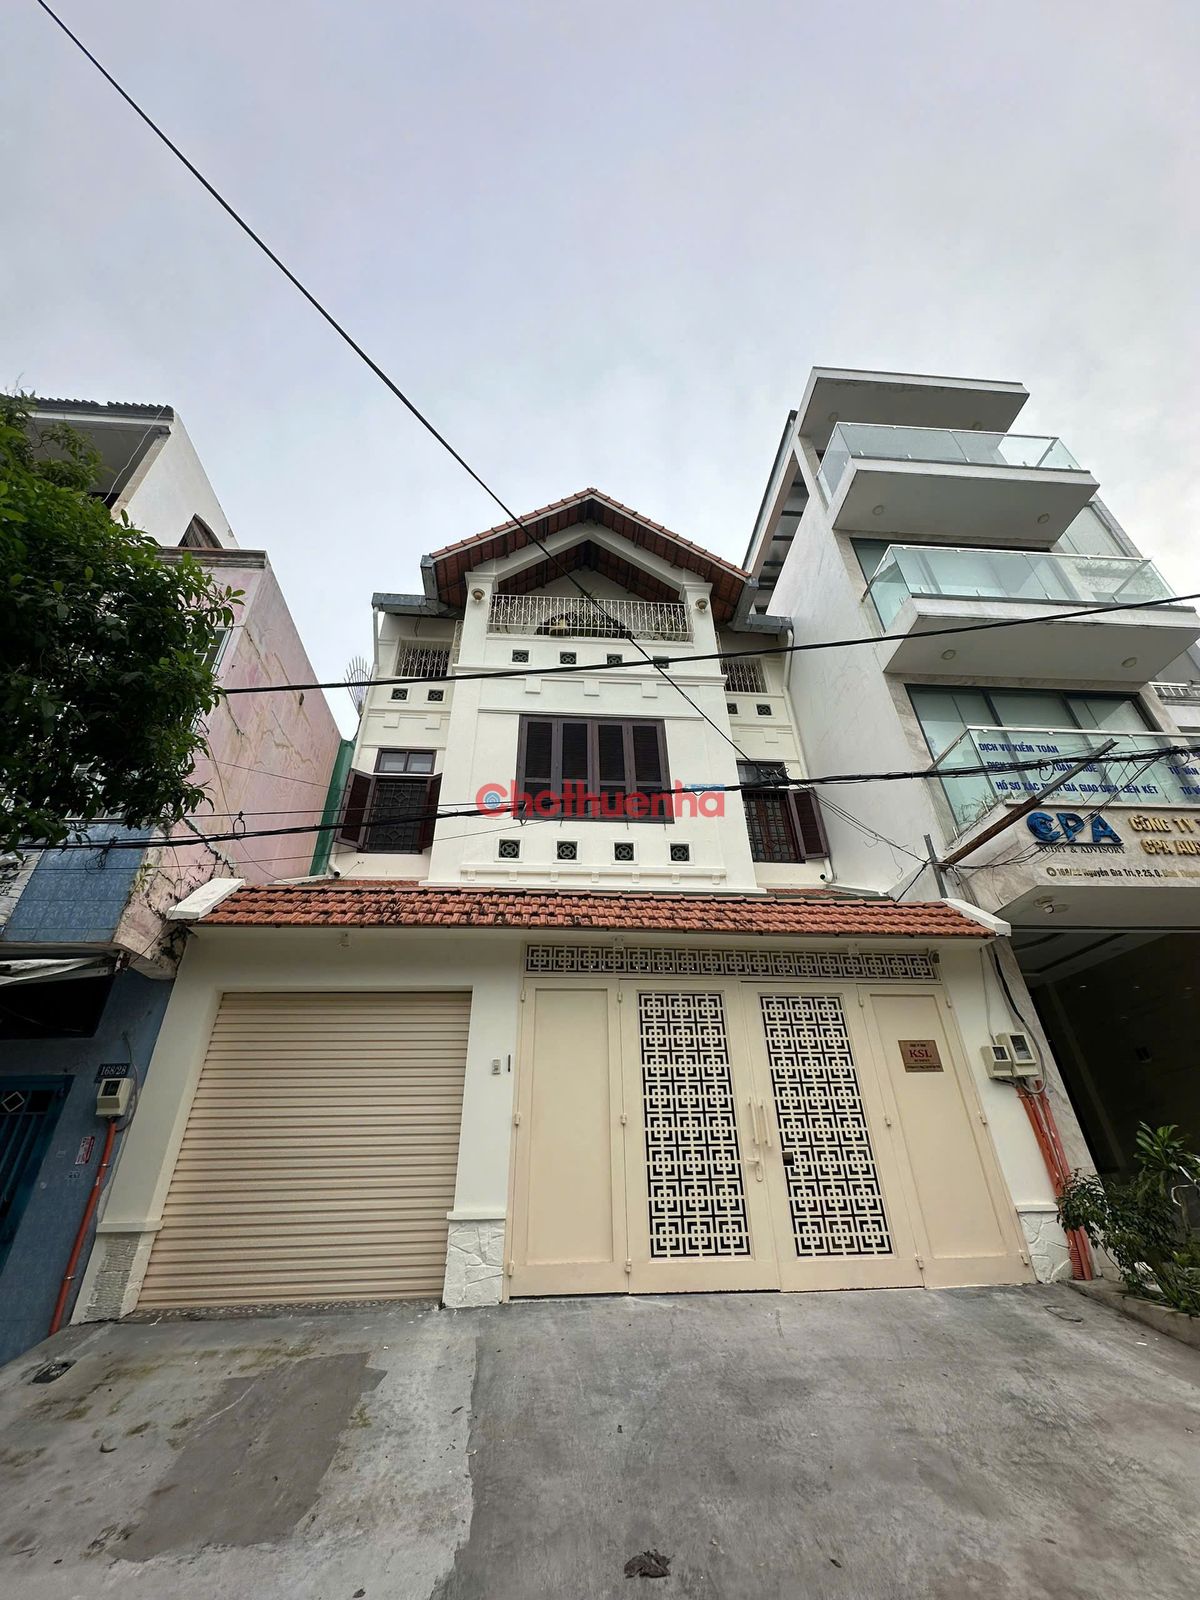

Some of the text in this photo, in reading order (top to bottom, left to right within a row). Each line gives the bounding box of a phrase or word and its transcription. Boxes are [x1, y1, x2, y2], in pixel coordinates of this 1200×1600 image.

[978, 743, 999, 752] DỊCH
[1026, 811, 1122, 843] CPA
[1128, 814, 1195, 833] CÔNG TY
[1039, 846, 1126, 854] AUDIT & ADVISORY
[1140, 839, 1175, 855] CPA
[1110, 868, 1122, 877] Gia
[909, 1049, 932, 1058] KSL
[100, 1065, 128, 1076] 168/28
